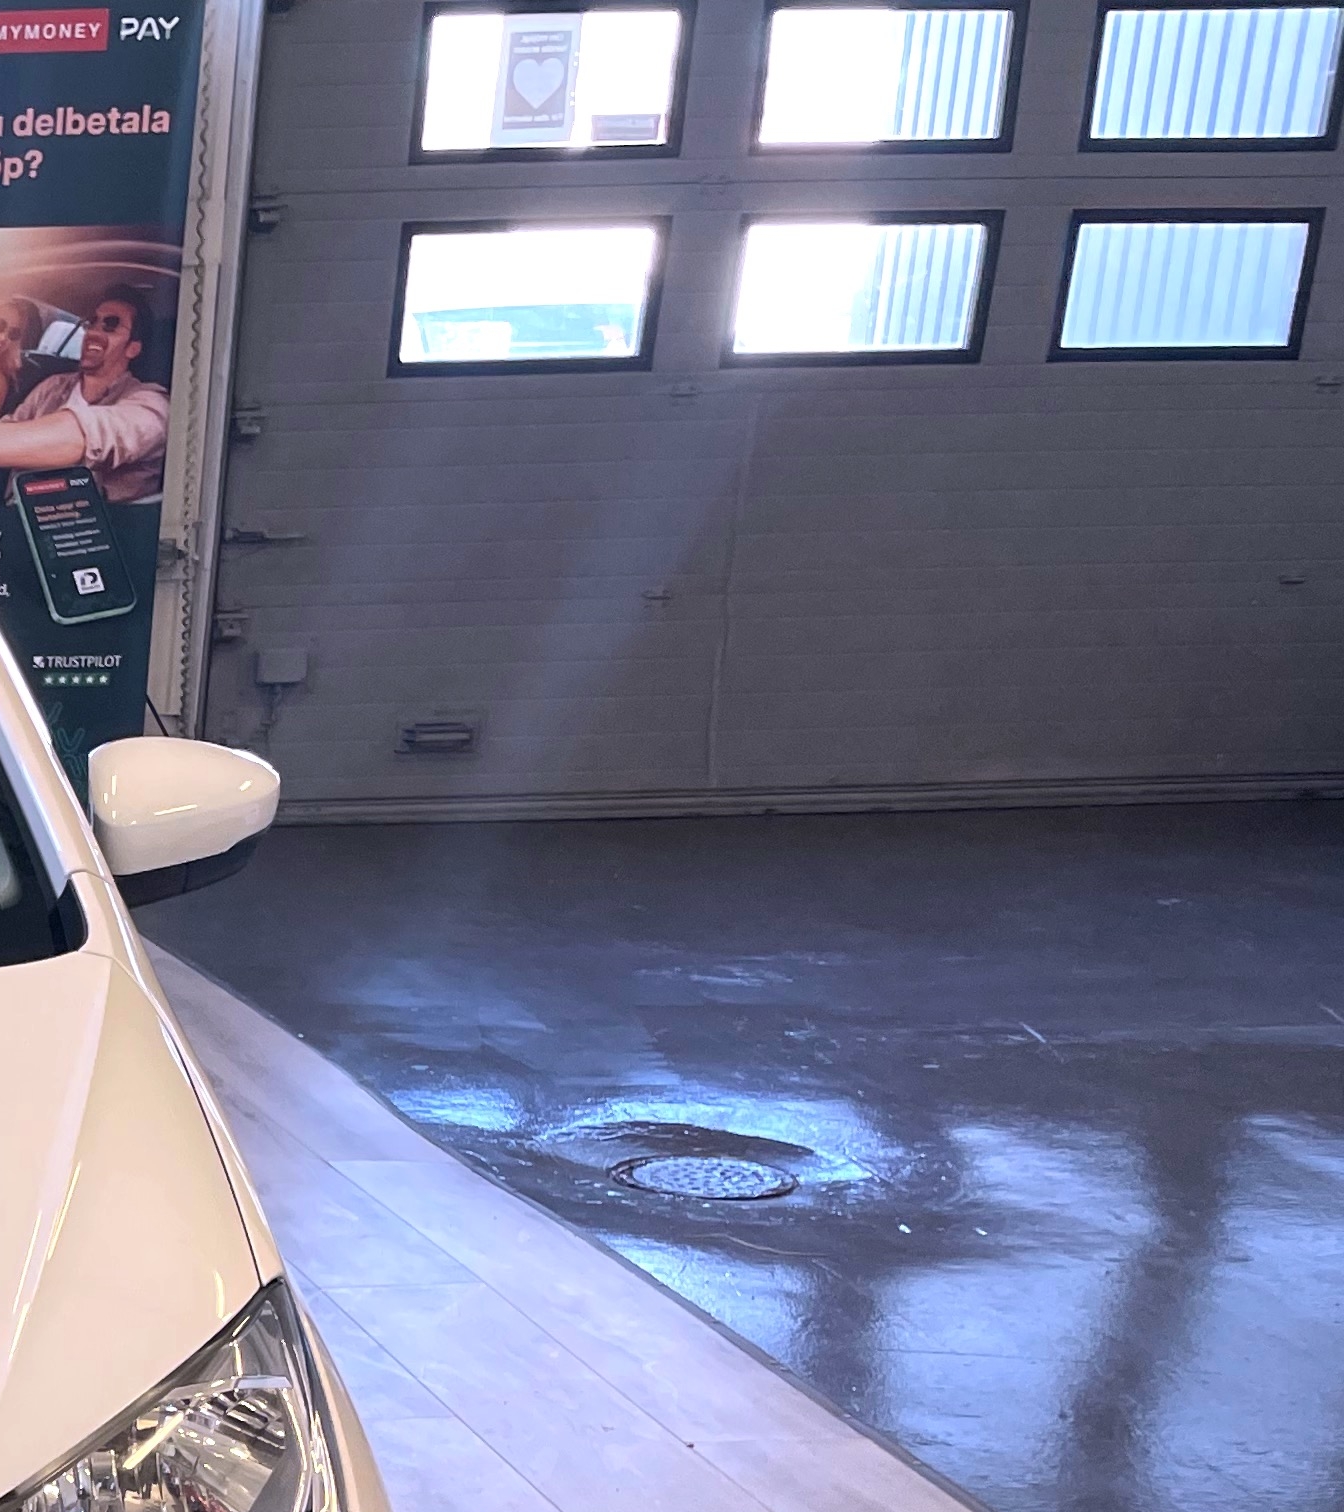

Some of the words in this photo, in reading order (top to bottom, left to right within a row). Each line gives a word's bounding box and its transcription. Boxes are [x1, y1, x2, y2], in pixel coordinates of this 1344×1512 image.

[119, 15, 180, 41] PAY
[12, 104, 171, 138] delbetala
[46, 654, 123, 669] TRUSTPILOT
